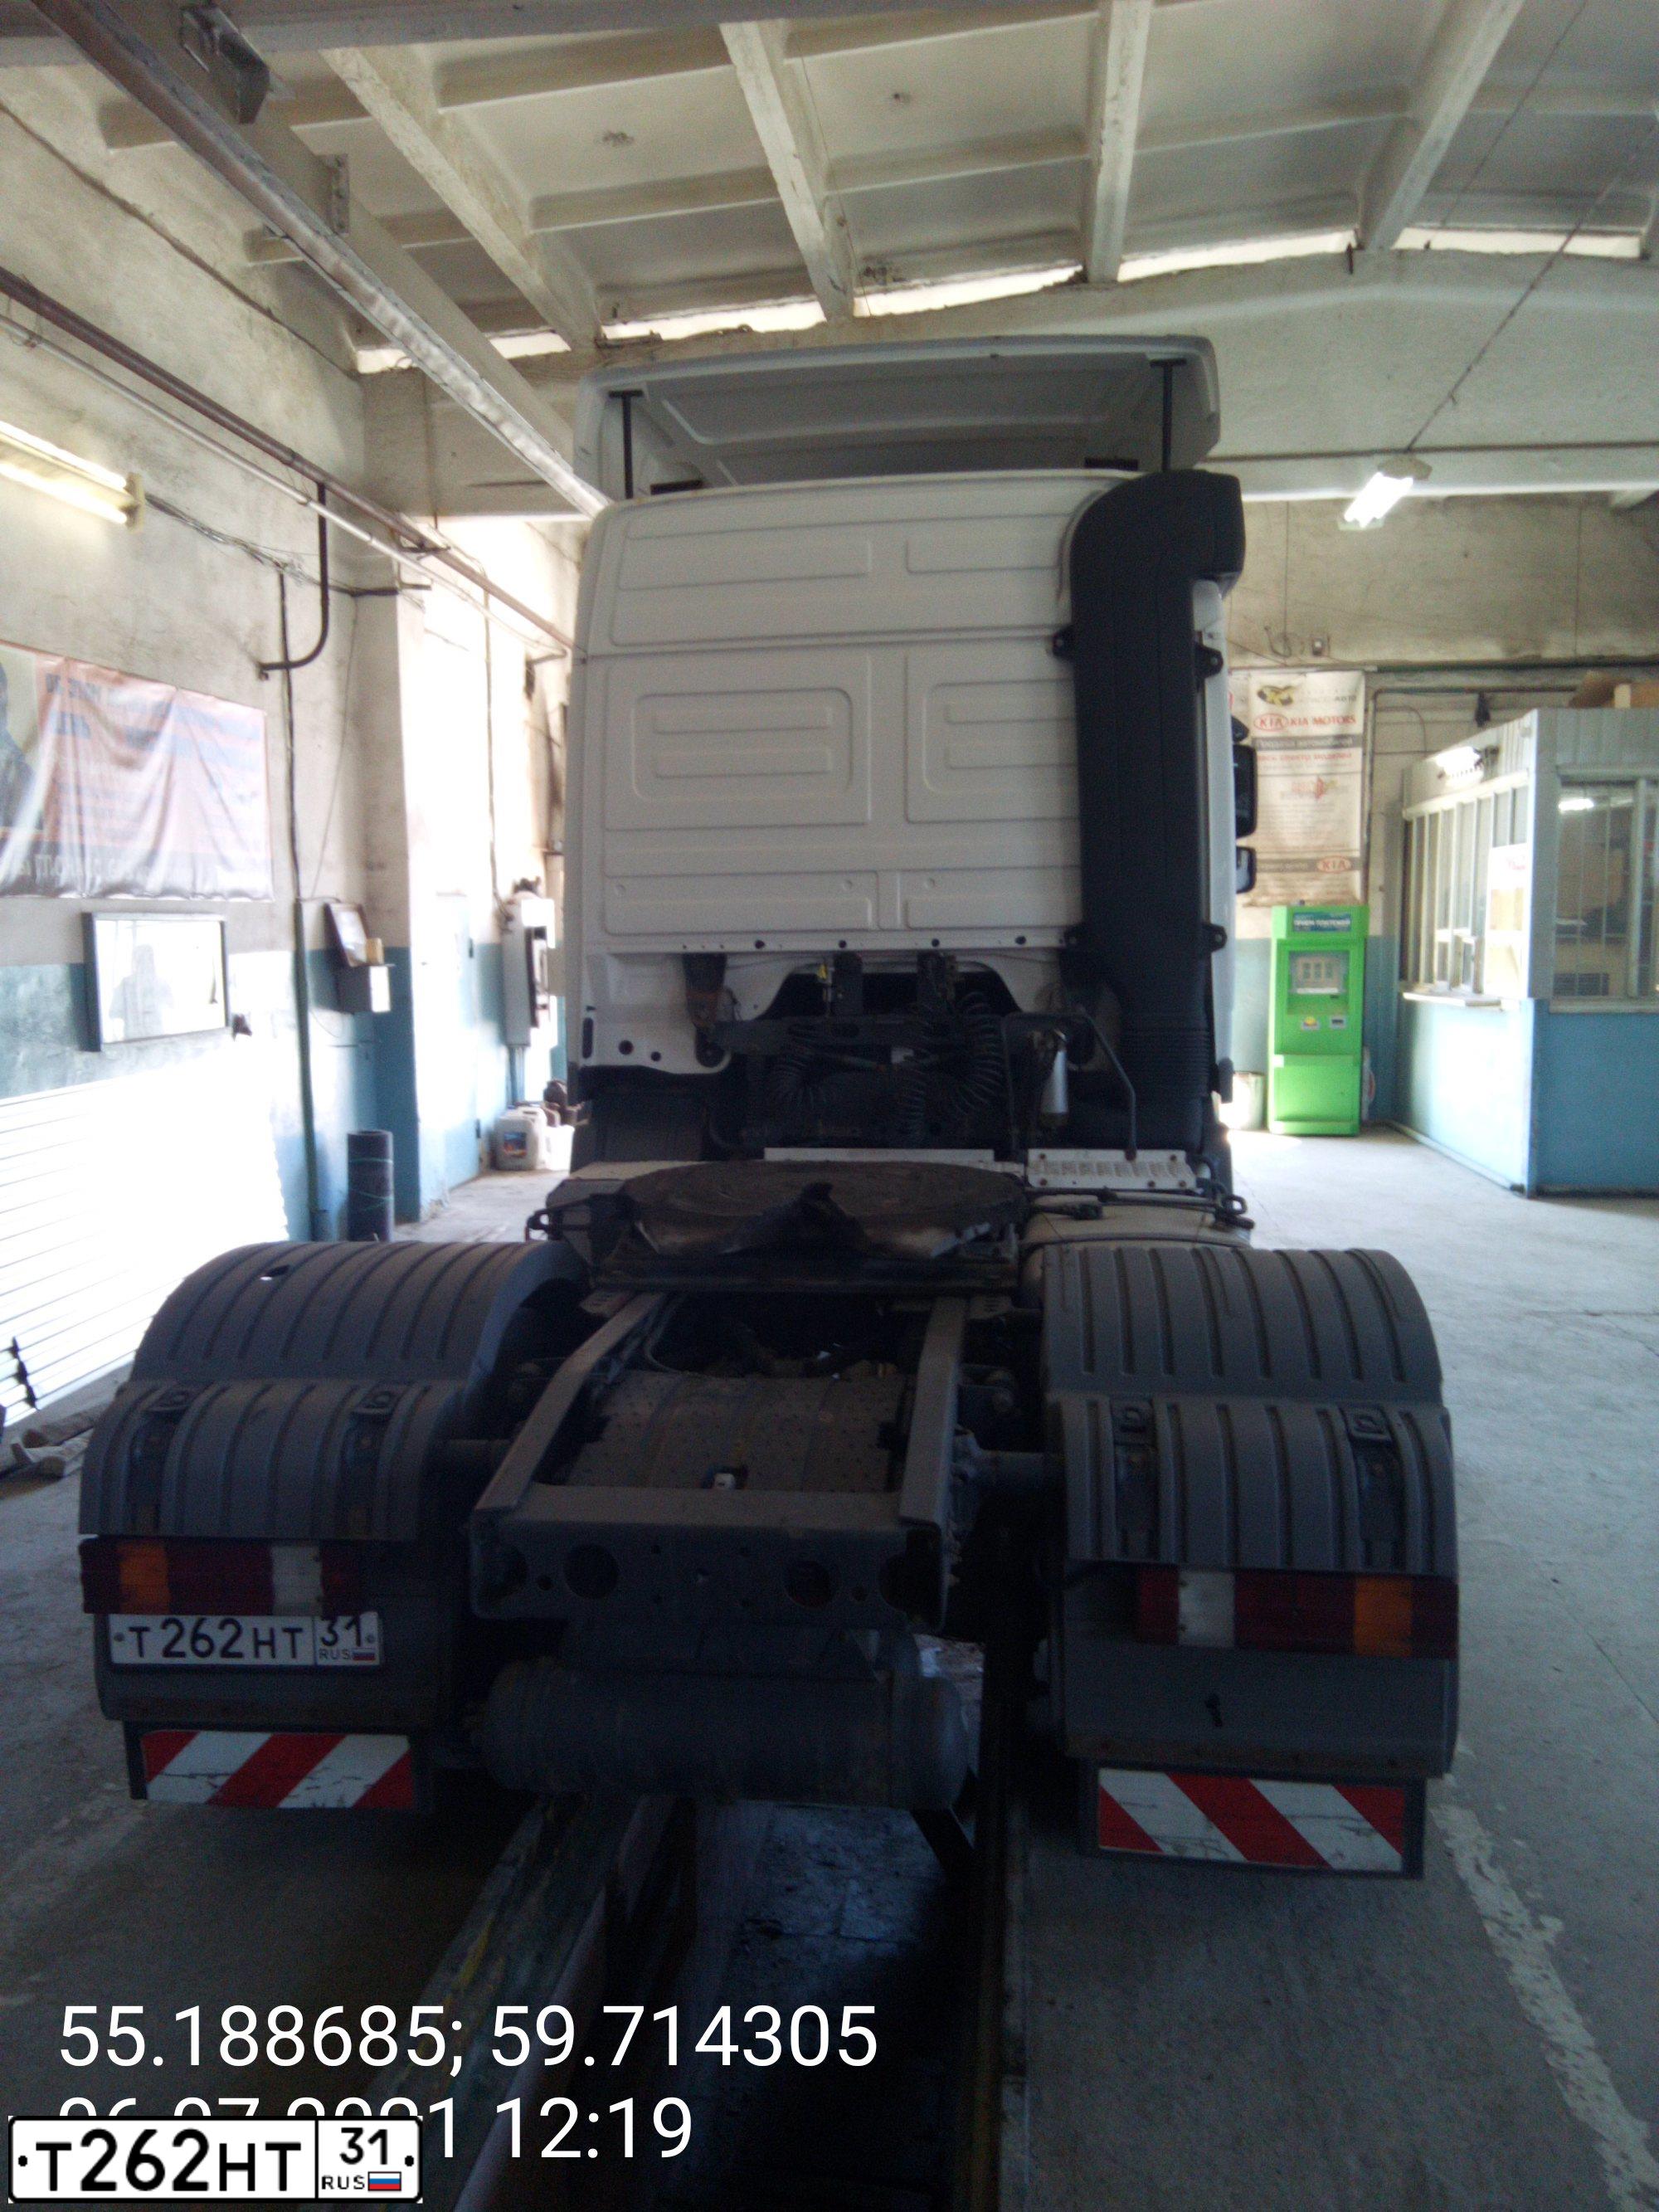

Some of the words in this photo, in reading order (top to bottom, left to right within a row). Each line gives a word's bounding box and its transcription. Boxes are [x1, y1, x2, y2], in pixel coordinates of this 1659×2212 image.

[1287, 715, 1309, 727] KIA
[1312, 714, 1357, 726] MOTORS
[321, 1615, 362, 1647] 31
[319, 1649, 351, 1660] RUS
